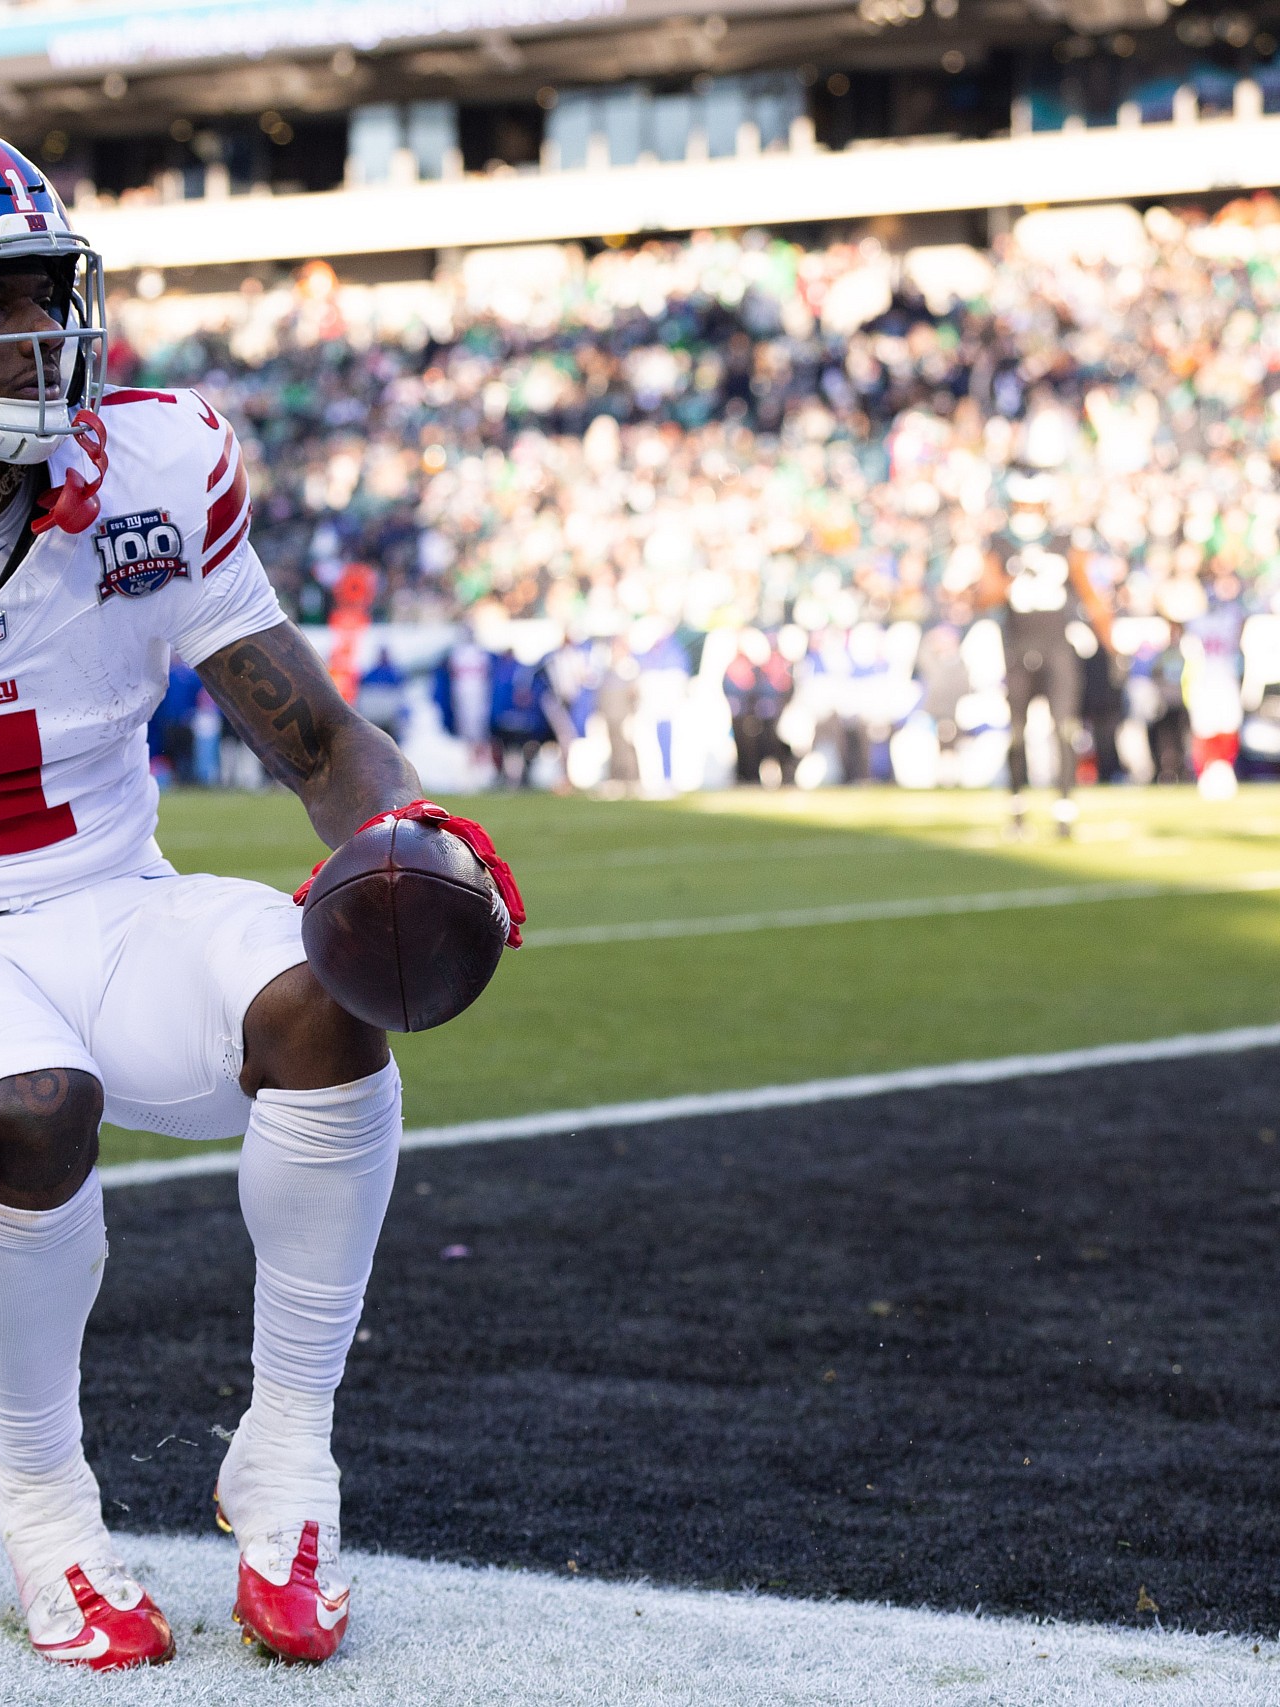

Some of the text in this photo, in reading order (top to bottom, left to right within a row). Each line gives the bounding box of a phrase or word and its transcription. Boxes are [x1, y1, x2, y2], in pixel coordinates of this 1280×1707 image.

[4, 169, 34, 211] 1
[142, 515, 159, 525] 1925
[96, 525, 181, 574] 100
[110, 560, 175, 582] SEASONS
